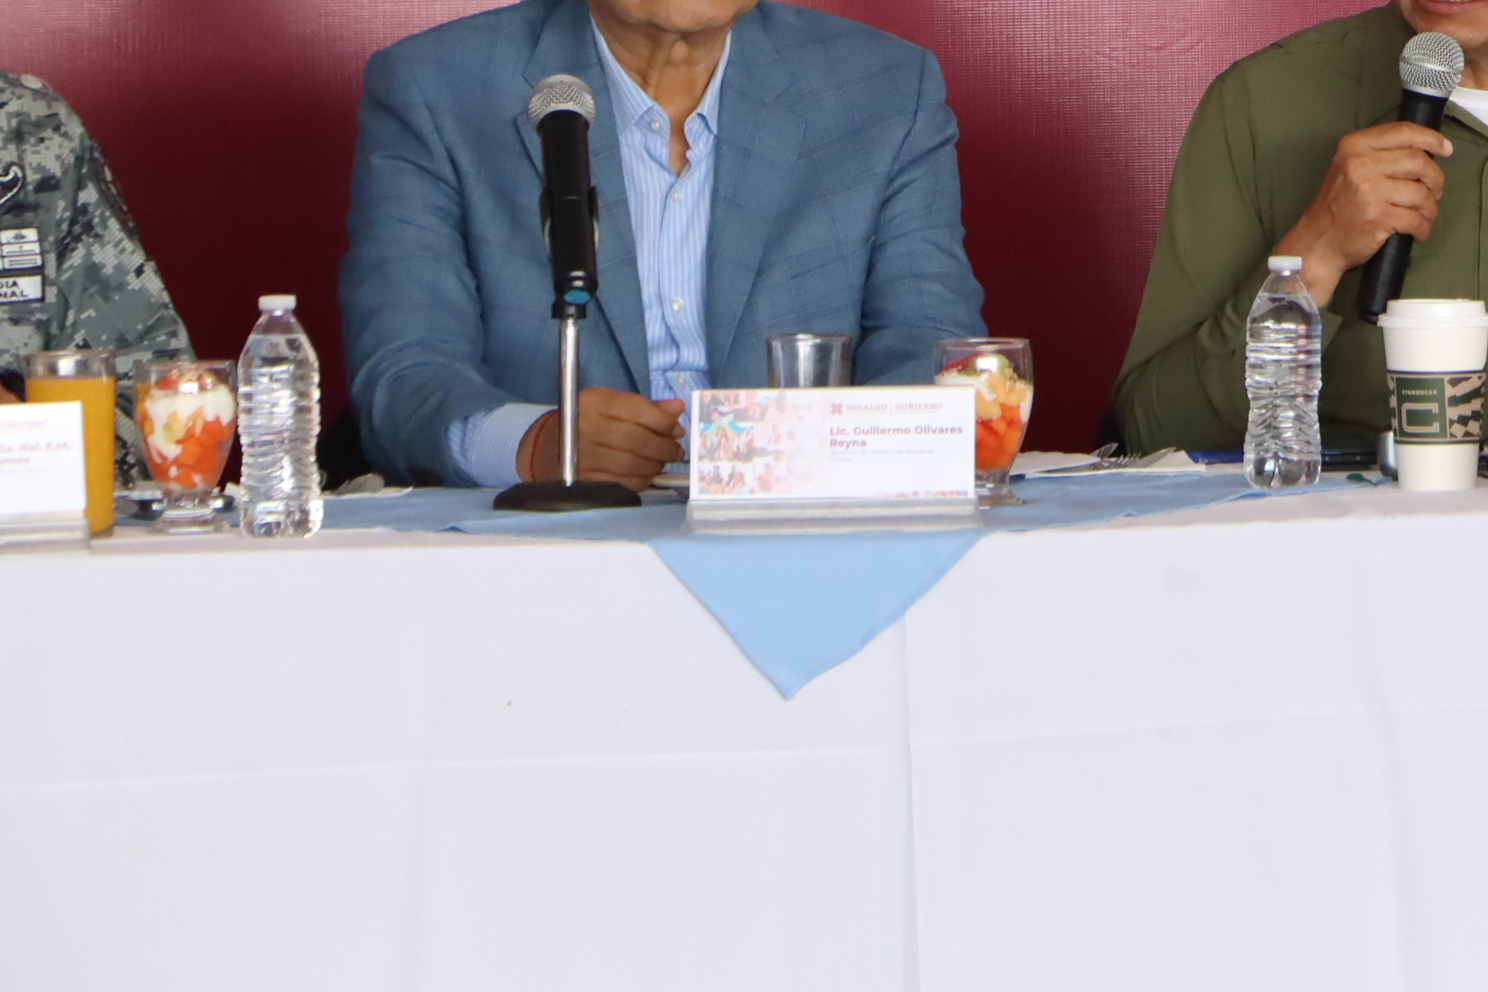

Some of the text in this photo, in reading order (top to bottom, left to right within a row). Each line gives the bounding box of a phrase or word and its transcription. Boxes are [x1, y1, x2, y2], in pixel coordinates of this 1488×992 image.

[846, 403, 943, 412] HIDALGO GOBIERNO
[829, 424, 963, 436] Lic. Guillermo Olivares
[829, 438, 867, 450] Reyna
